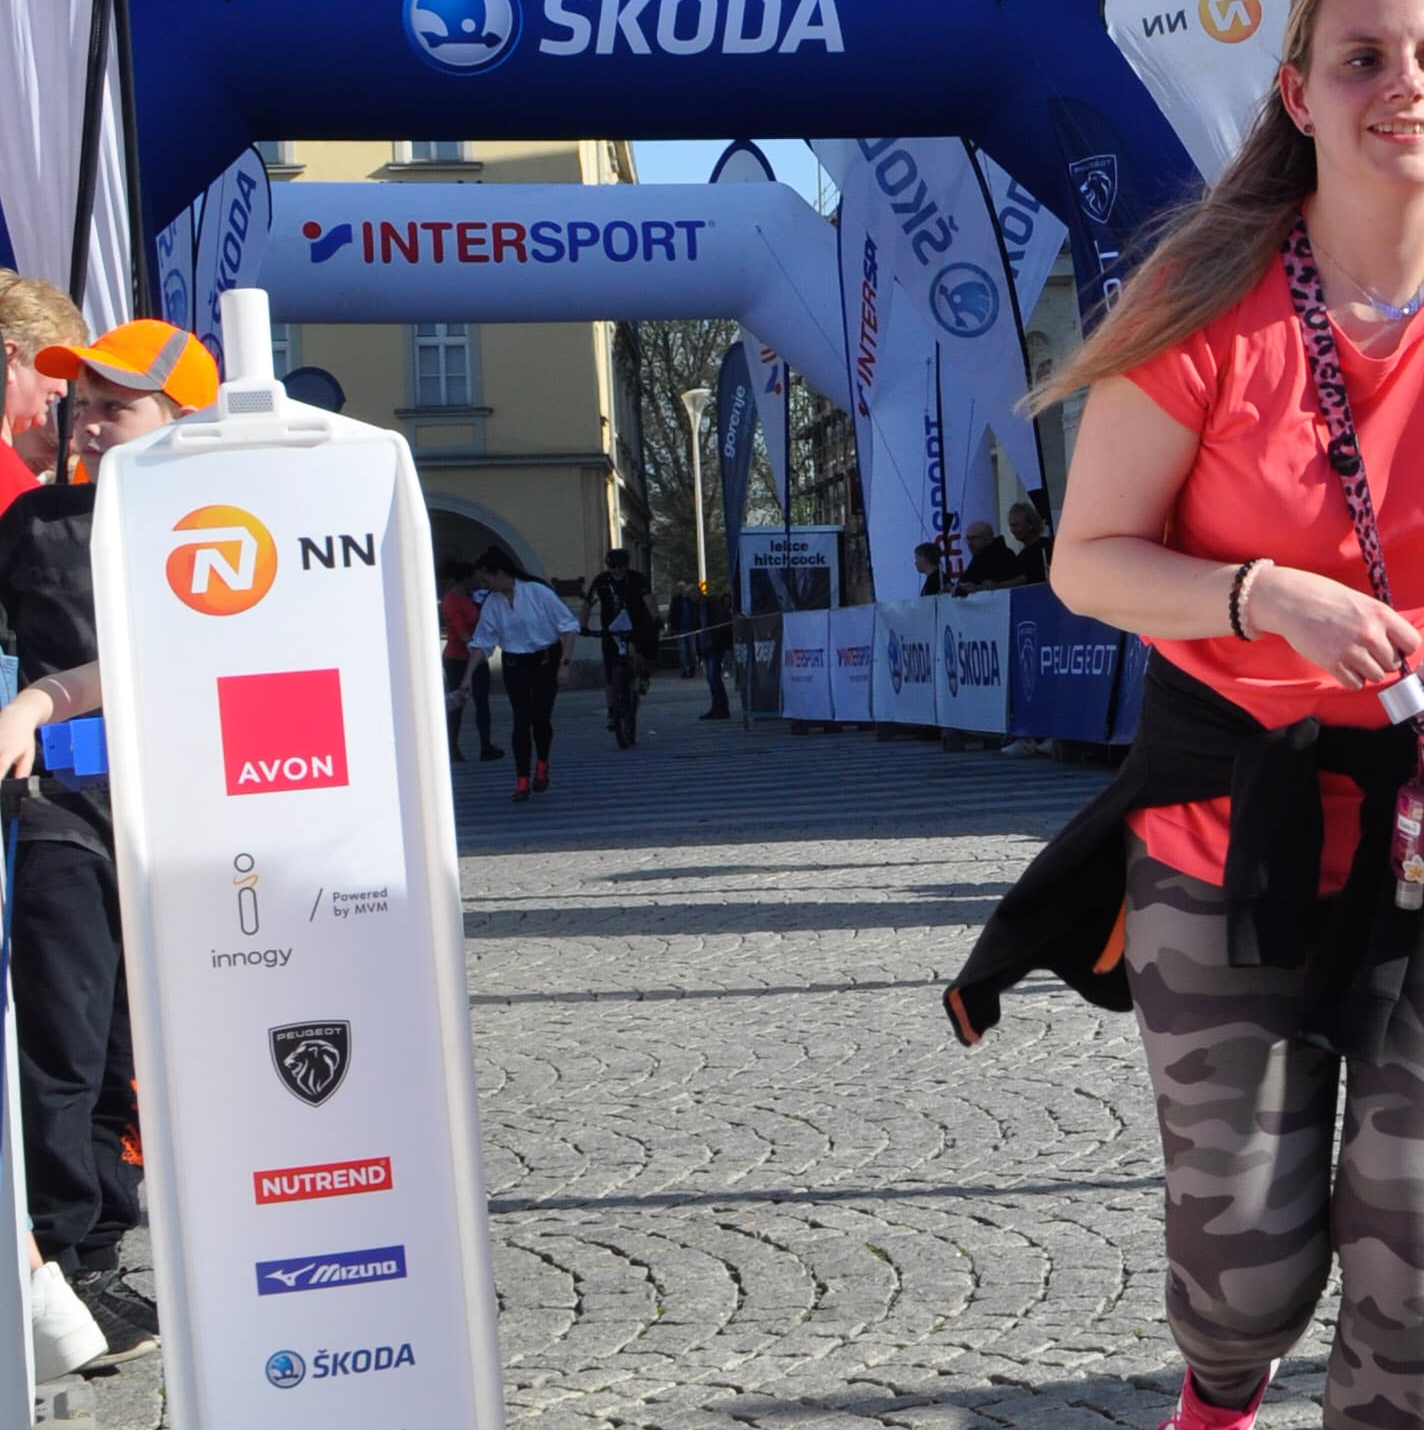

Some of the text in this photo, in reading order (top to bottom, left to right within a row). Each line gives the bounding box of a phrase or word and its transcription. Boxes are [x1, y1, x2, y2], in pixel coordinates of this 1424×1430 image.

[362, 220, 706, 264] INTERSPORT
[723, 384, 747, 460] gorenje
[297, 532, 377, 572] NN
[753, 552, 827, 566] hitchcock
[770, 539, 809, 553] lekce
[956, 630, 1001, 686] ŠKODA
[1040, 644, 1118, 676] PEUGEOT
[237, 754, 335, 786] AVON
[332, 885, 389, 903] Powered
[333, 899, 389, 918] by MVM
[210, 945, 294, 971] innogy
[276, 1025, 344, 1042] PEUGEOT
[261, 1163, 387, 1199] NUTREND
[311, 1342, 416, 1380] ŠKODA
